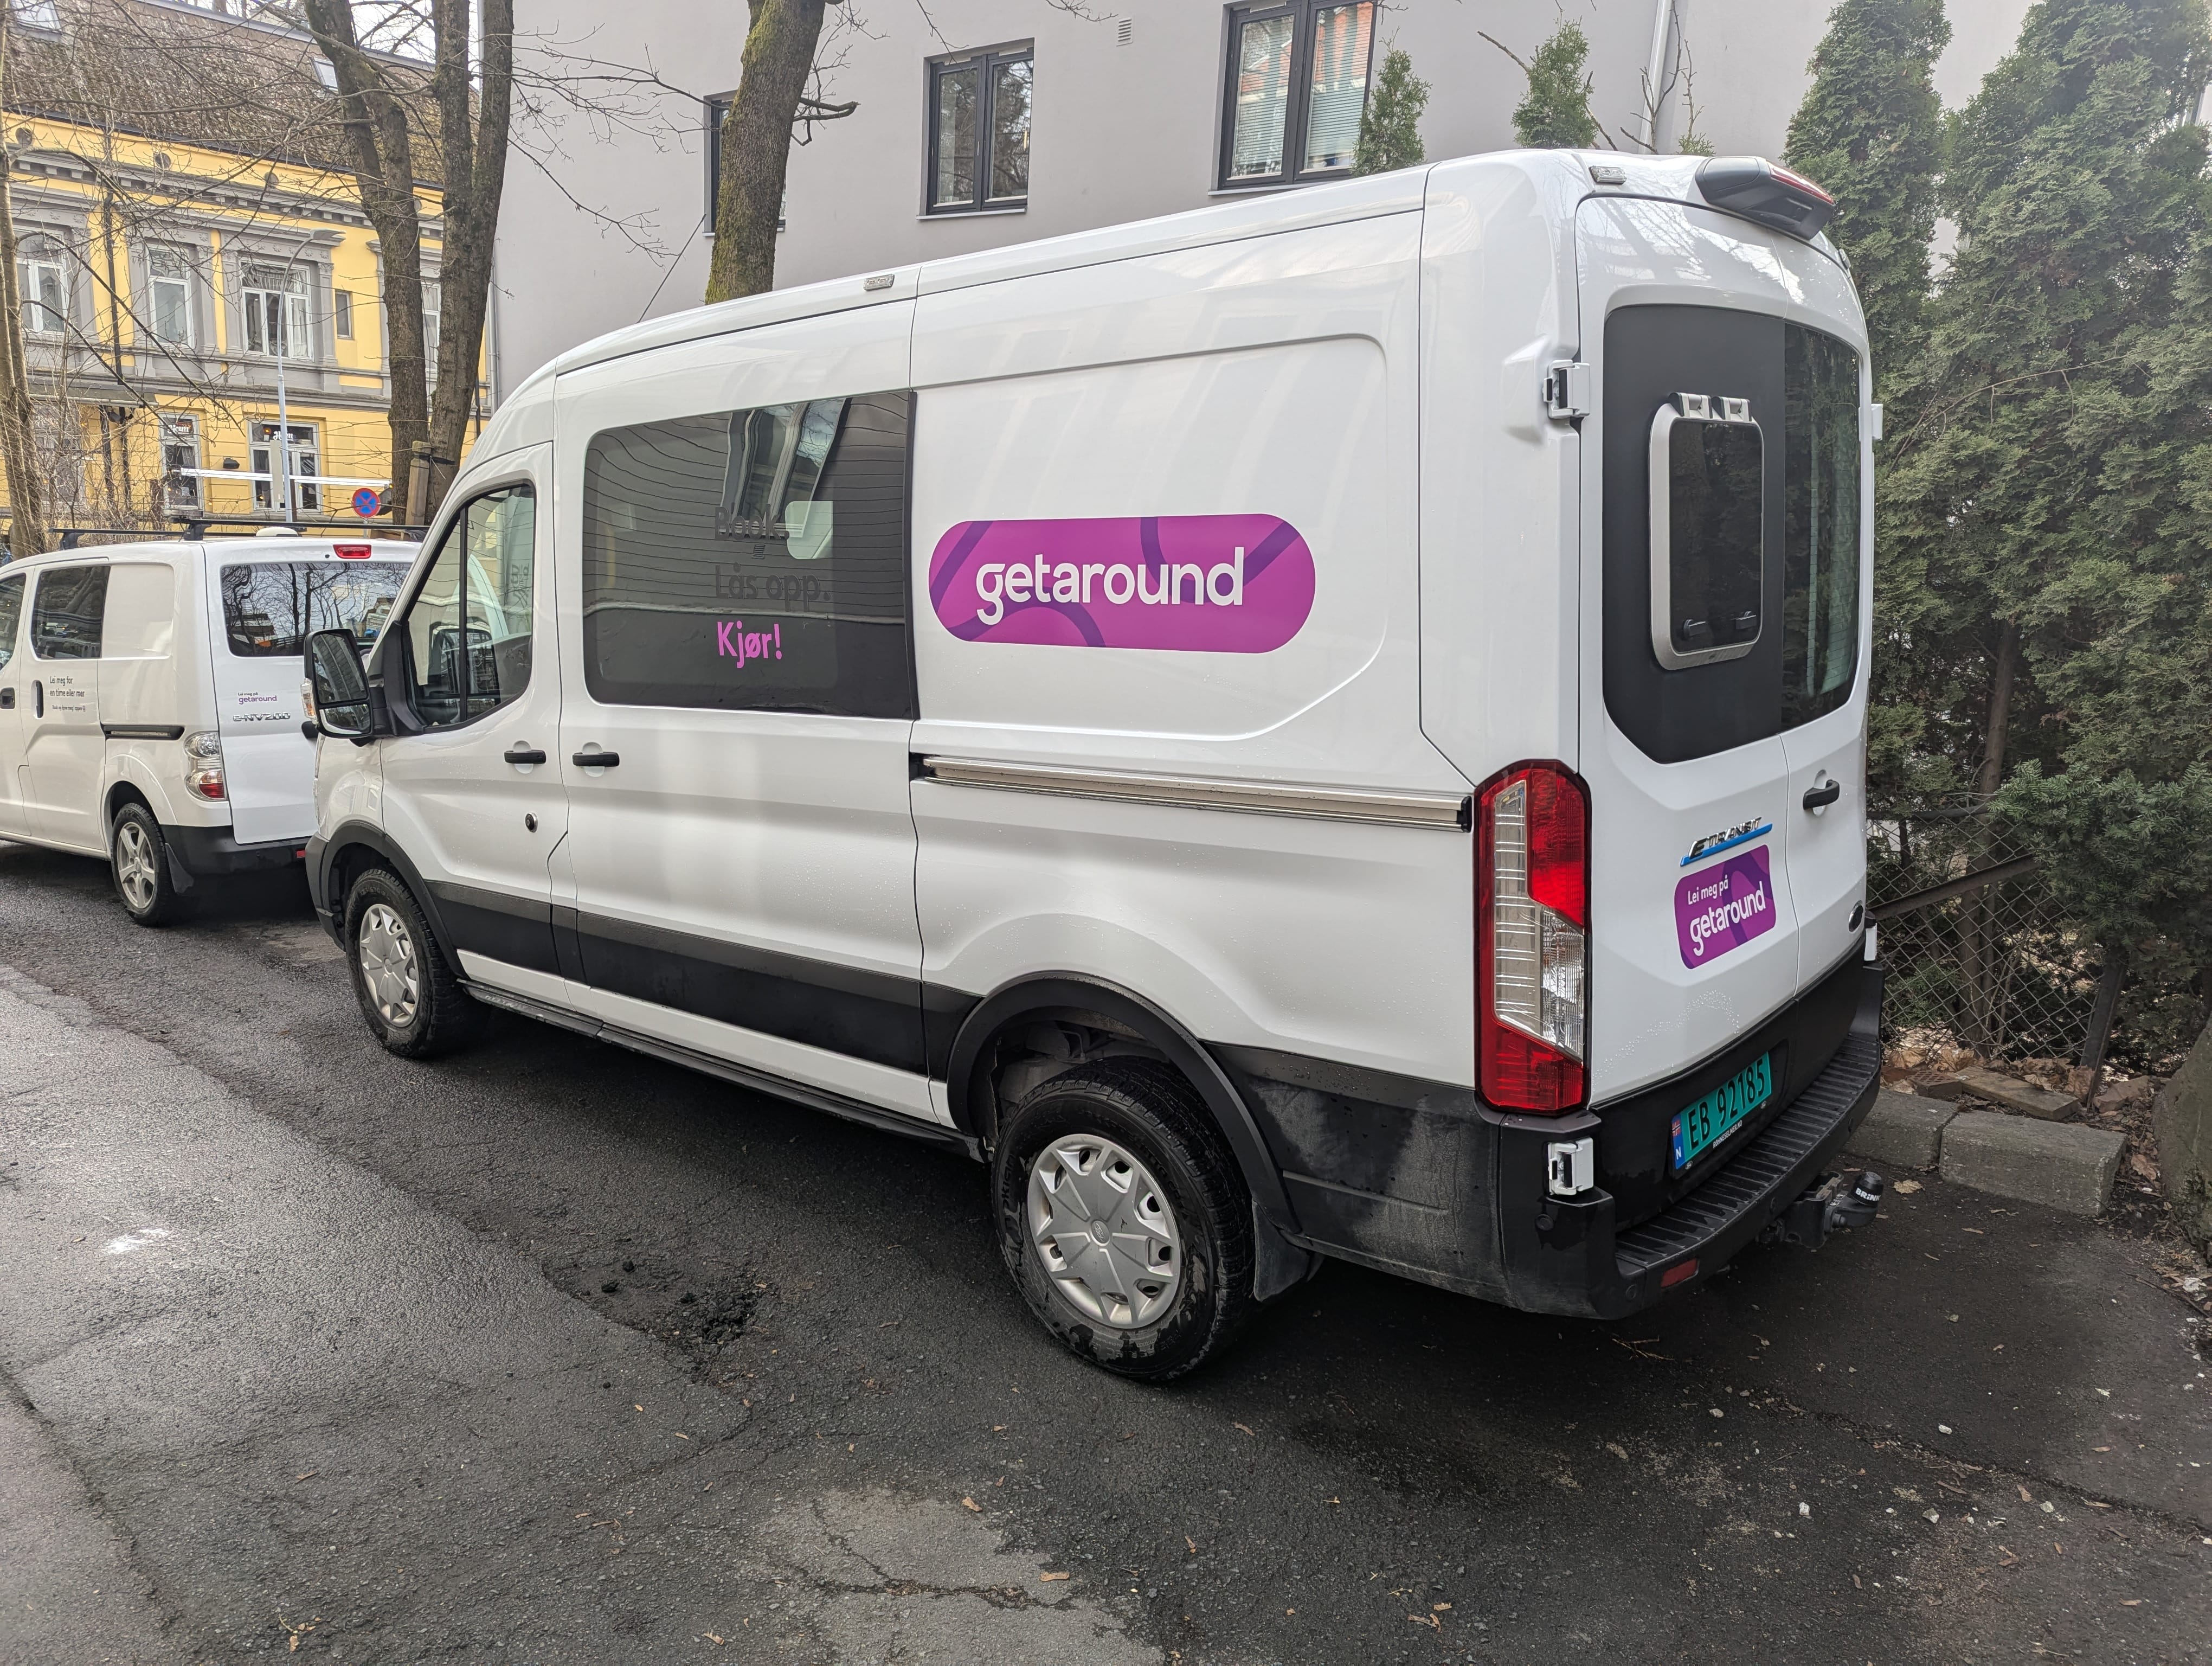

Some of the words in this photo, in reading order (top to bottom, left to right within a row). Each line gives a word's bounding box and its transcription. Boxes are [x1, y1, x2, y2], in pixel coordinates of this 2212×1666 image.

[715, 503, 790, 541] Book.
[715, 561, 758, 599] Lås
[766, 574, 832, 612] opp.
[976, 546, 1245, 625] getaround
[717, 620, 782, 669] Kjør!
[56, 678, 66, 687] meg
[56, 688, 66, 696] time
[66, 688, 75, 697] eller
[239, 695, 277, 704] getaround
[1688, 886, 1699, 905] Lei
[1701, 883, 1717, 899] meg
[1719, 874, 1729, 896] på
[1690, 881, 1766, 956] getaround
[1687, 1101, 1711, 1151] EB
[1716, 1059, 1765, 1128] 92185
[1675, 1146, 1682, 1160] N
